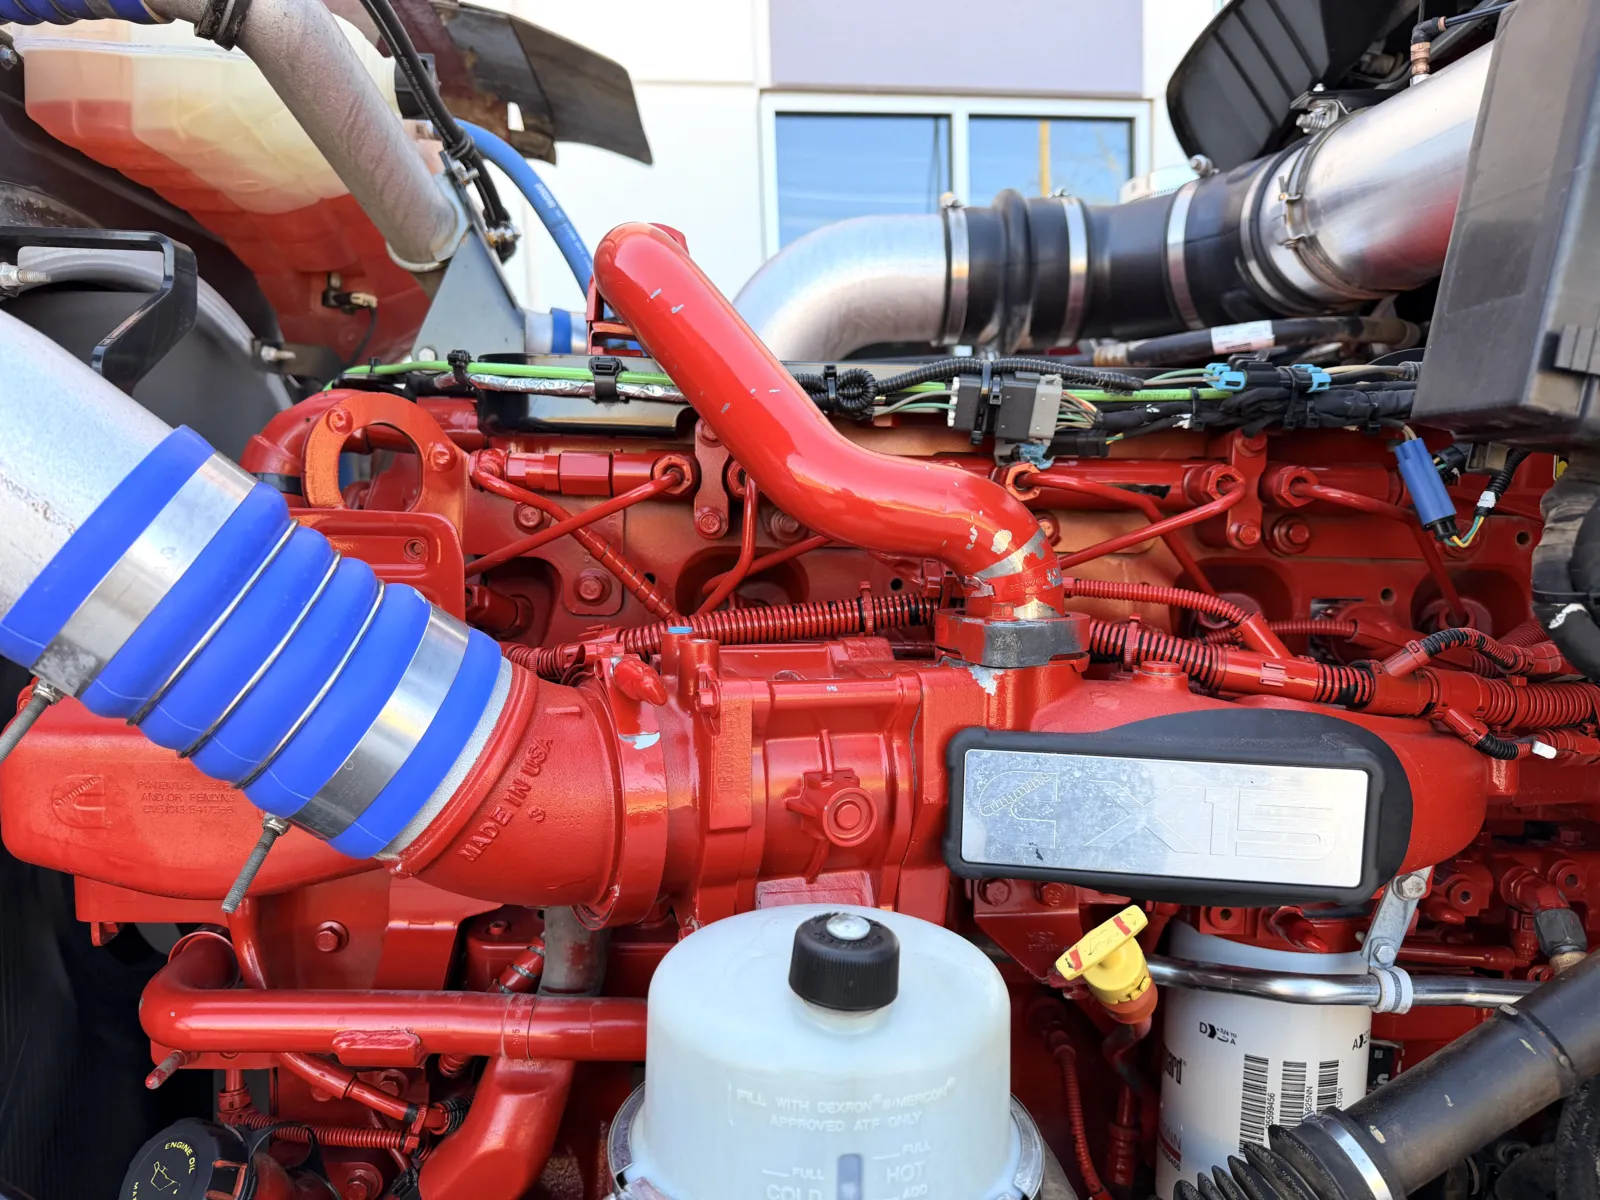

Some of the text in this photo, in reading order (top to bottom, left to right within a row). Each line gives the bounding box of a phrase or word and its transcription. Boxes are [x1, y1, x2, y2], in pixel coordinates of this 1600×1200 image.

[53, 774, 102, 810] Cummins
[459, 739, 554, 862] MADE IN USA
[979, 772, 1052, 817] Cummins
[1084, 779, 1336, 862] X15
[736, 1088, 768, 1108] FILL
[776, 1096, 810, 1114] WITH
[769, 1110, 923, 1132] APPROVED ATF ONLY
[164, 1141, 196, 1175] ENGINE OIL
[901, 1139, 932, 1155] FULL
[792, 1166, 825, 1181] FULL
[886, 1161, 926, 1184] HOT
[903, 1184, 929, 1200] ADD
